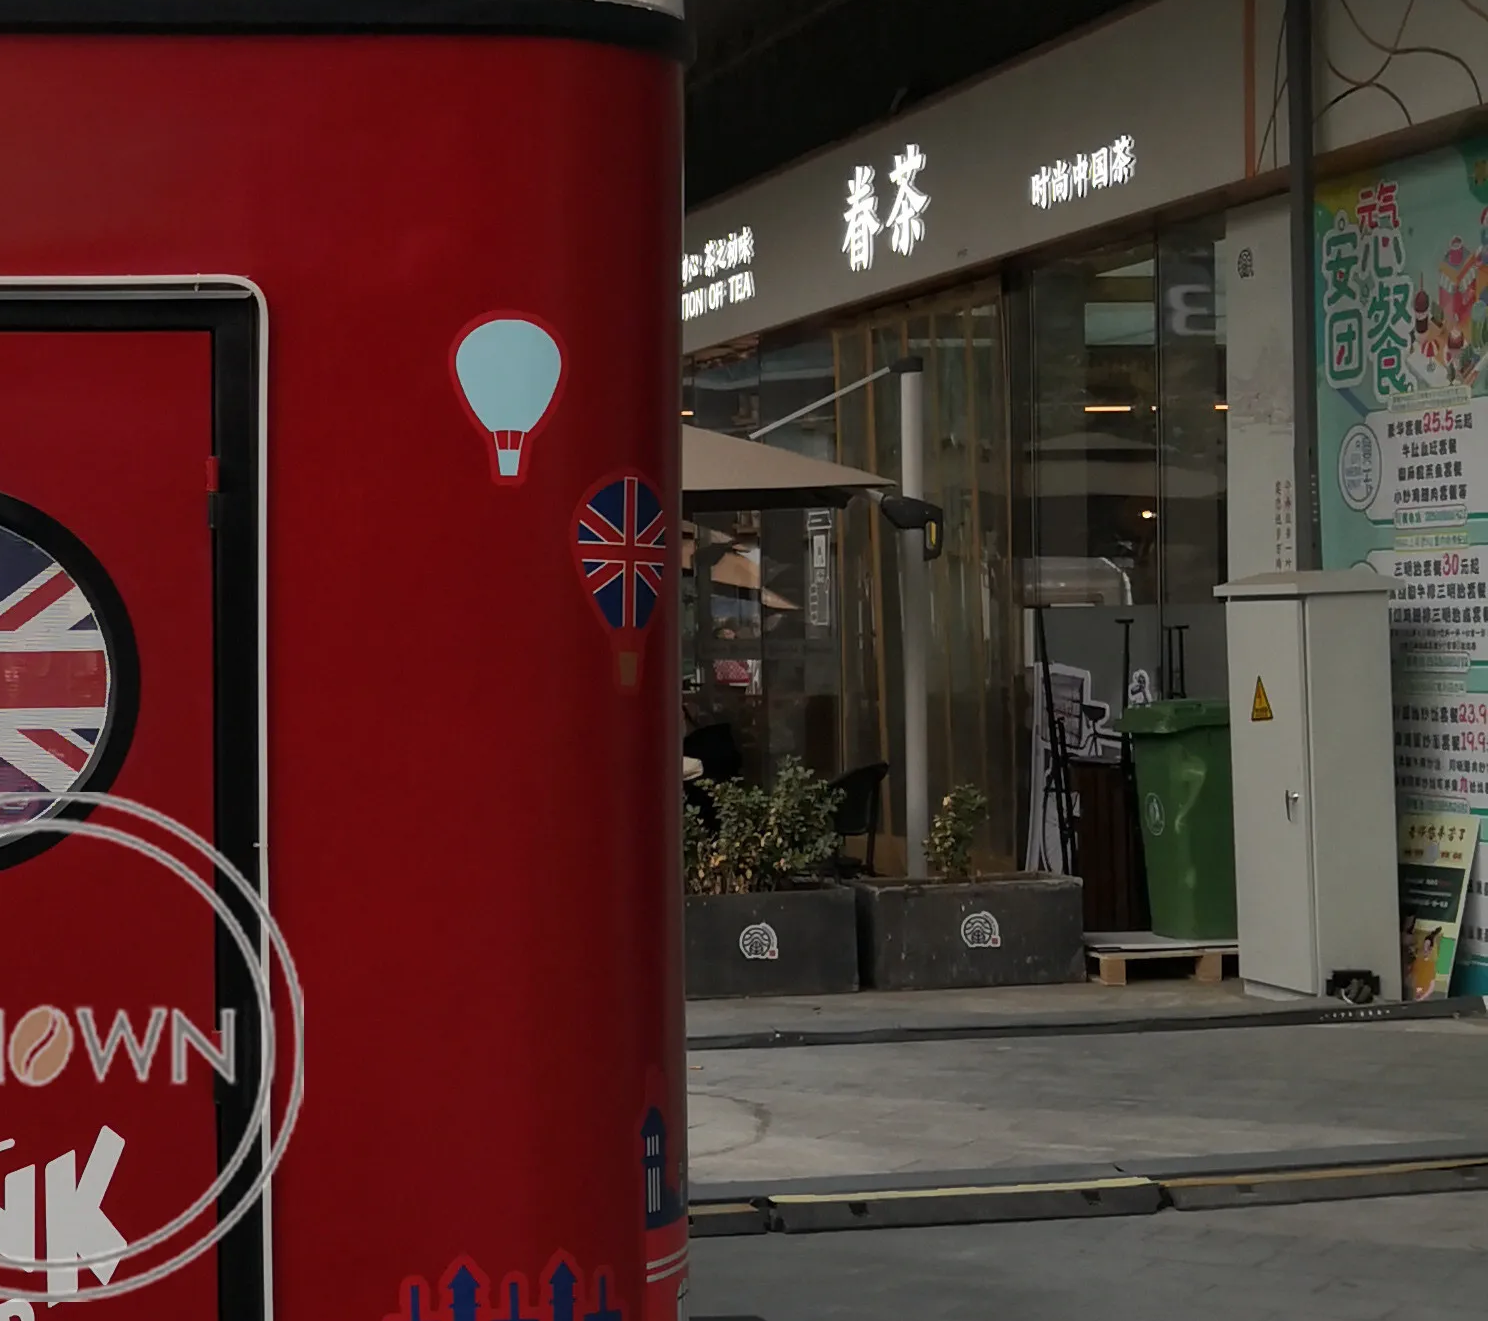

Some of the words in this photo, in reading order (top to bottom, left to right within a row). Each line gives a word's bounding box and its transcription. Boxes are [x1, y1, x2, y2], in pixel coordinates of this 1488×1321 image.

[1030, 135, 1133, 209] 时尚中国茶
[728, 271, 752, 304] TEA
